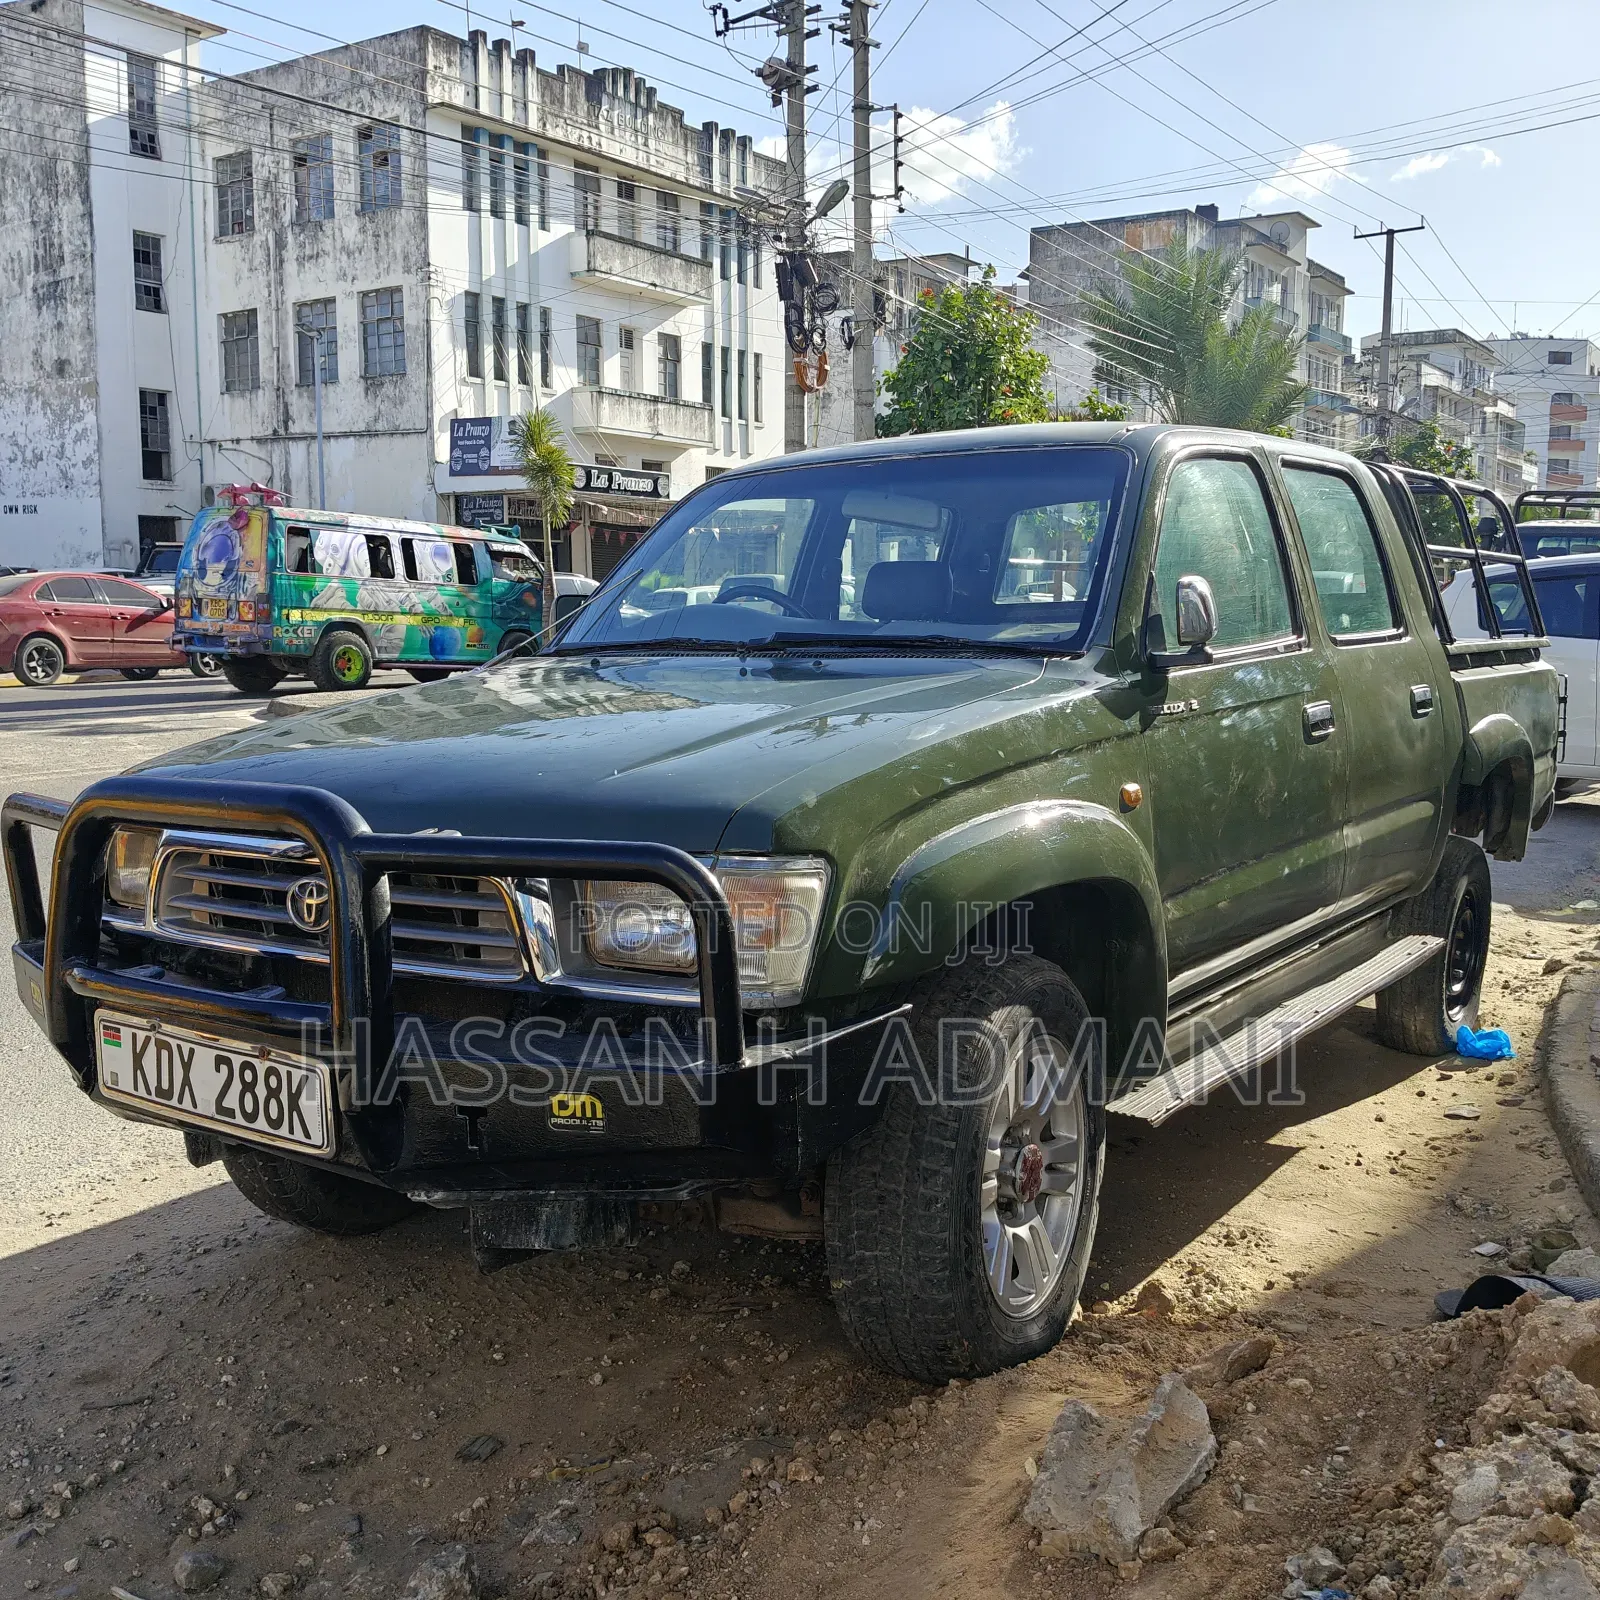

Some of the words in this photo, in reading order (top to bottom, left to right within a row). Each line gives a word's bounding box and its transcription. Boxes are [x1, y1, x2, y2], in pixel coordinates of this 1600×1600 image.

[618, 112, 665, 140] BUILDING
[453, 422, 464, 437] La
[465, 421, 490, 437] Pranzo
[590, 469, 609, 488] La
[611, 471, 654, 492] Pranzo
[3, 504, 19, 515] OWN
[22, 504, 39, 515] RISK
[463, 498, 474, 509] La
[475, 497, 503, 509] Pranzo
[361, 612, 394, 622] TUDOR
[421, 616, 441, 625] GPO
[273, 625, 318, 638] ROCKET
[131, 1031, 198, 1109] KDX
[214, 1053, 312, 1140] 288K
